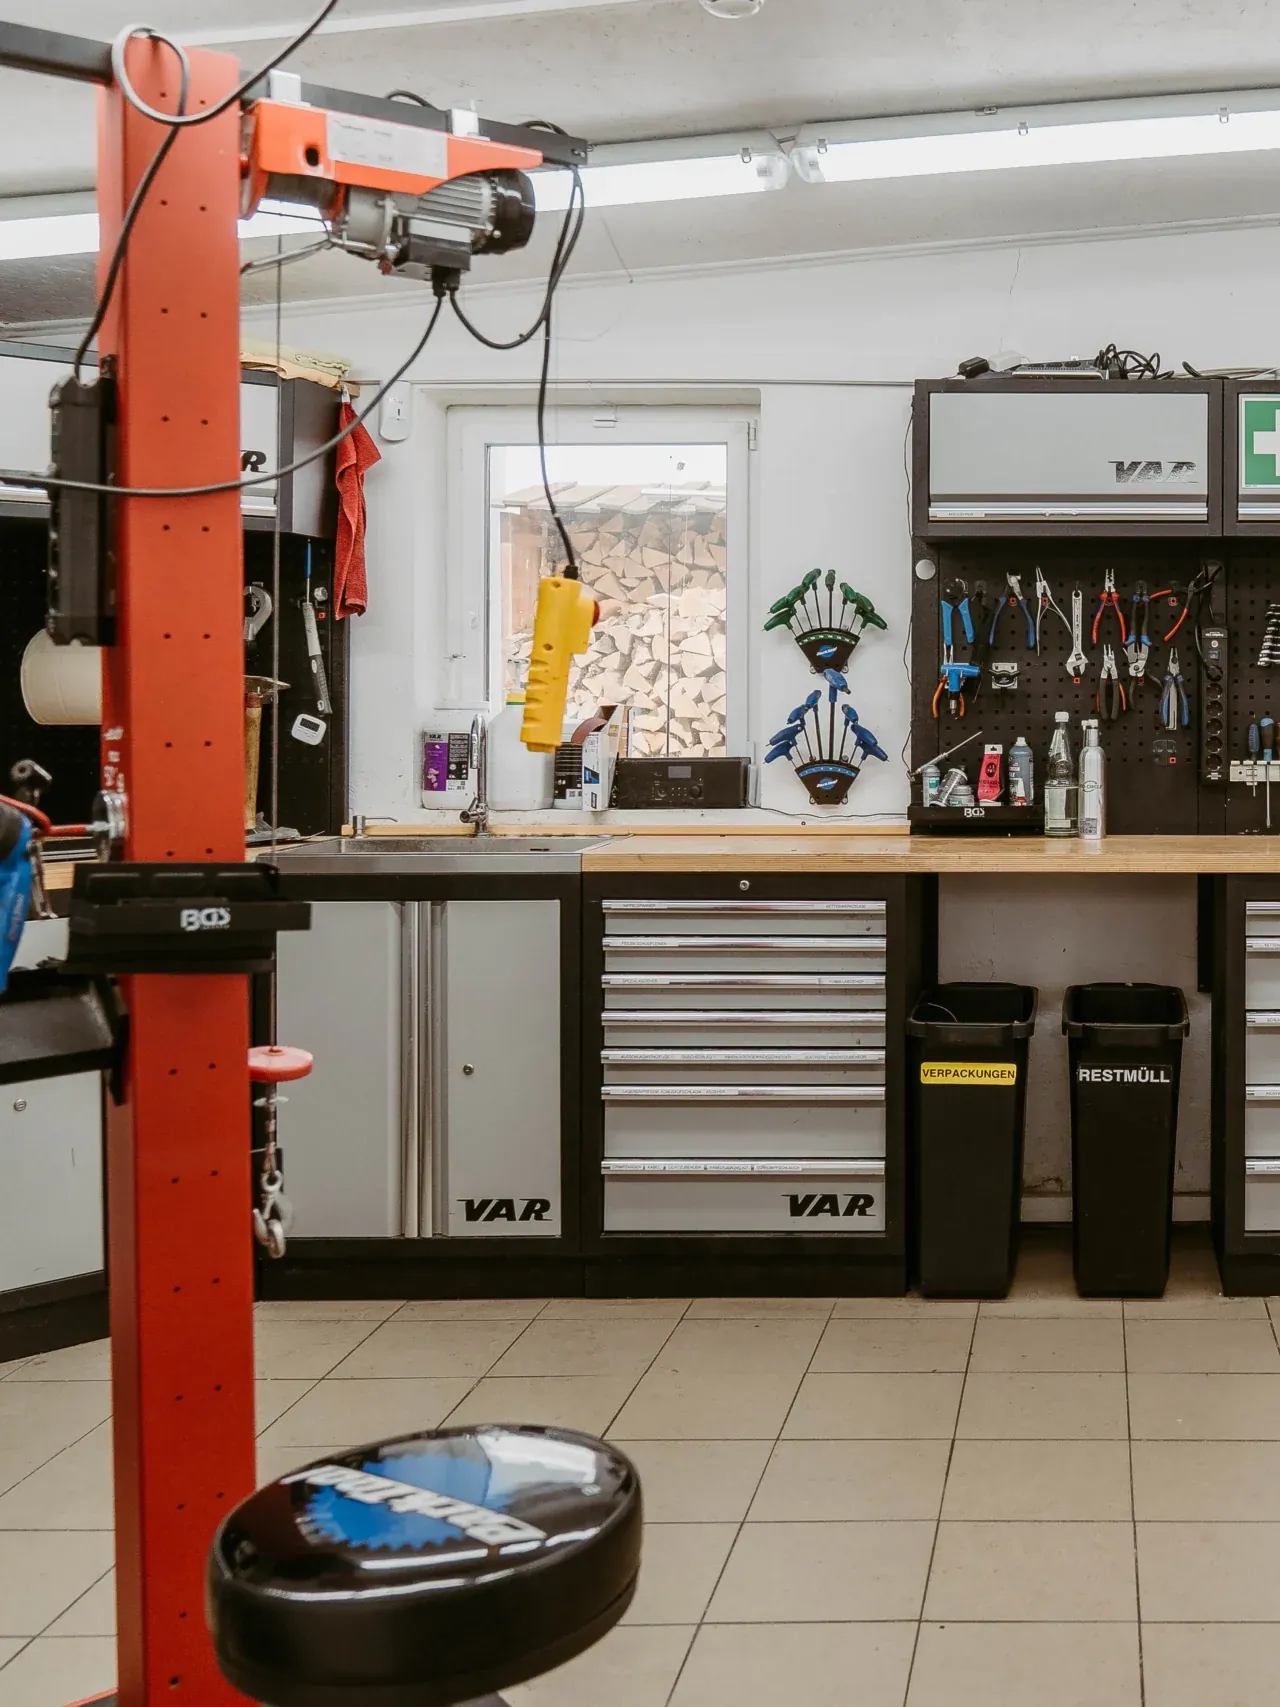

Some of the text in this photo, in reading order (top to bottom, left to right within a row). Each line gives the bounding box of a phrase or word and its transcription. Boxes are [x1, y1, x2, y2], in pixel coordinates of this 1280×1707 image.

[1108, 461, 1199, 484] VAR
[921, 1068, 1015, 1079] VERPACKUNGEN
[1079, 1066, 1170, 1083] RESTMÜLL
[457, 1198, 553, 1222] VAR
[781, 1193, 877, 1217] VAR
